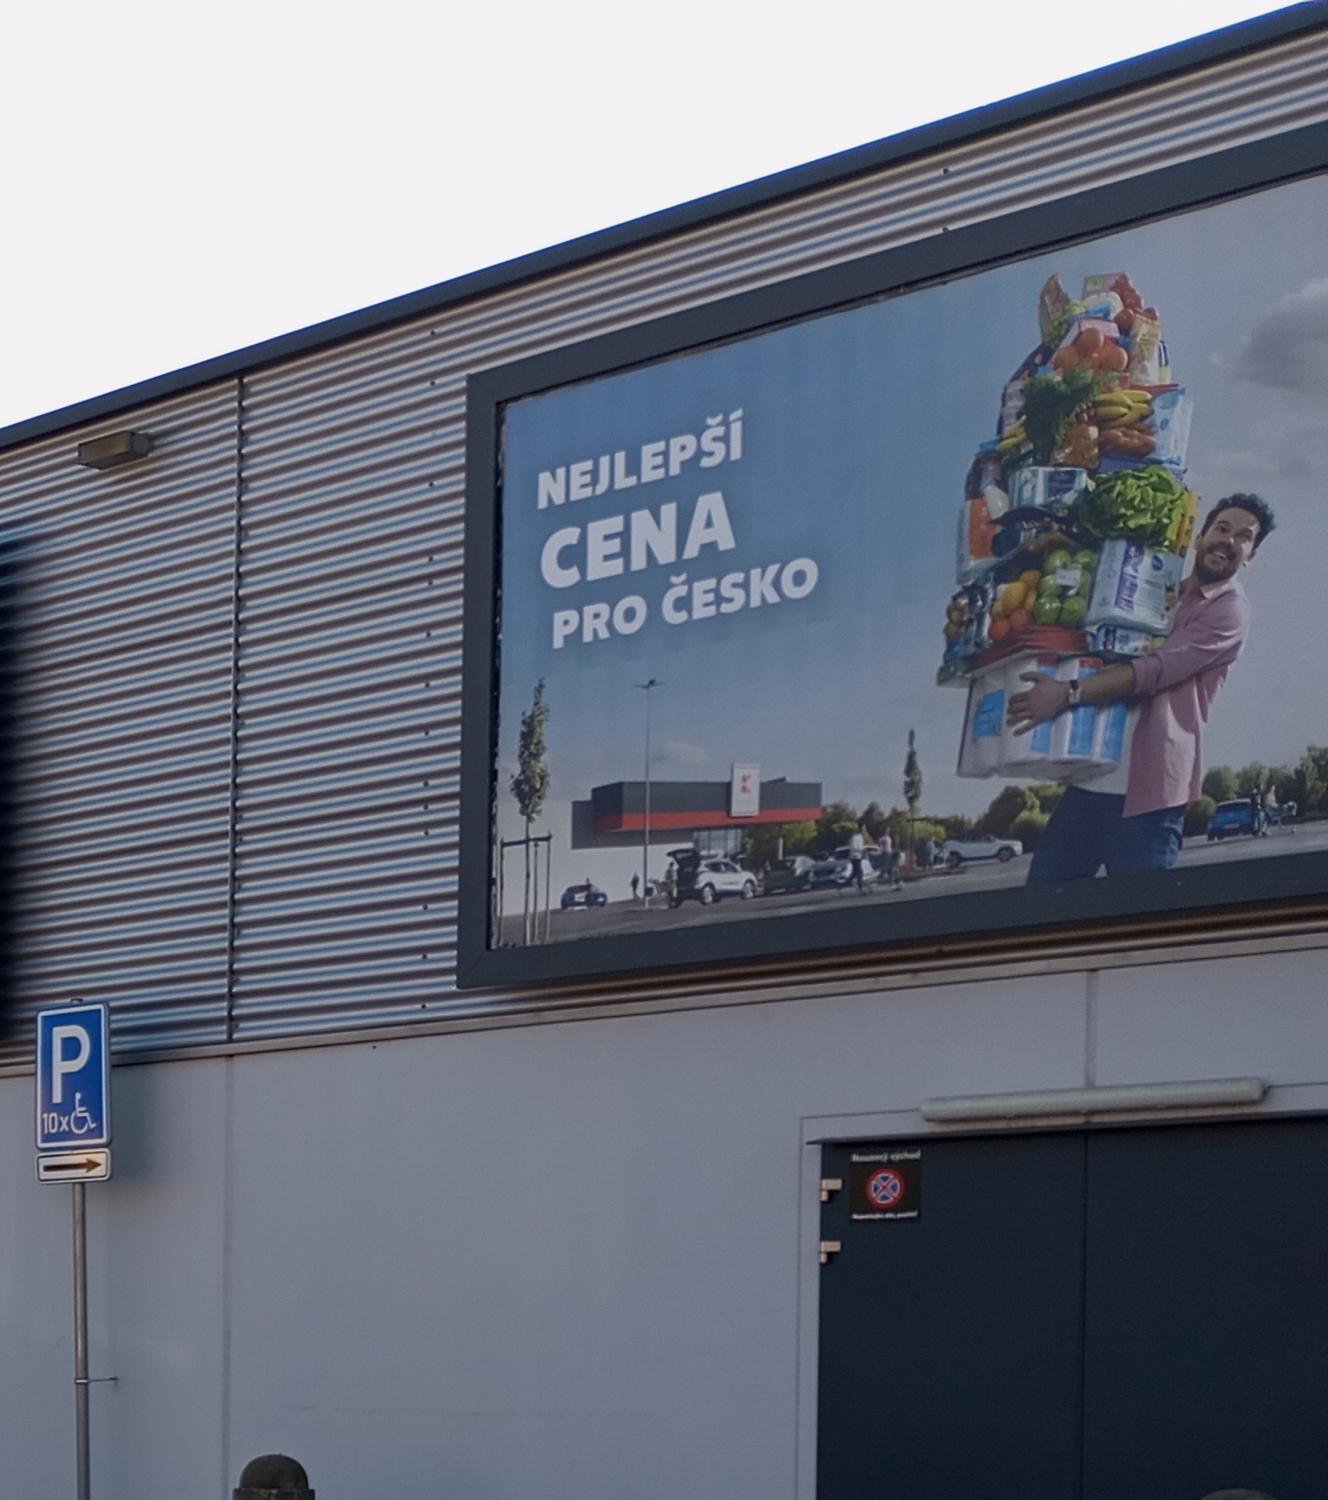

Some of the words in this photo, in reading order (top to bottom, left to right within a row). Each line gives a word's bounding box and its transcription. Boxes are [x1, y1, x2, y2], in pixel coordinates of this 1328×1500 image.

[537, 408, 744, 509] NEJLEPŠÍ
[540, 491, 737, 589] CENA
[552, 594, 648, 649] PRO
[661, 557, 820, 625] ČESKO
[52, 1024, 90, 1104] P
[42, 1112, 69, 1134] 10x
